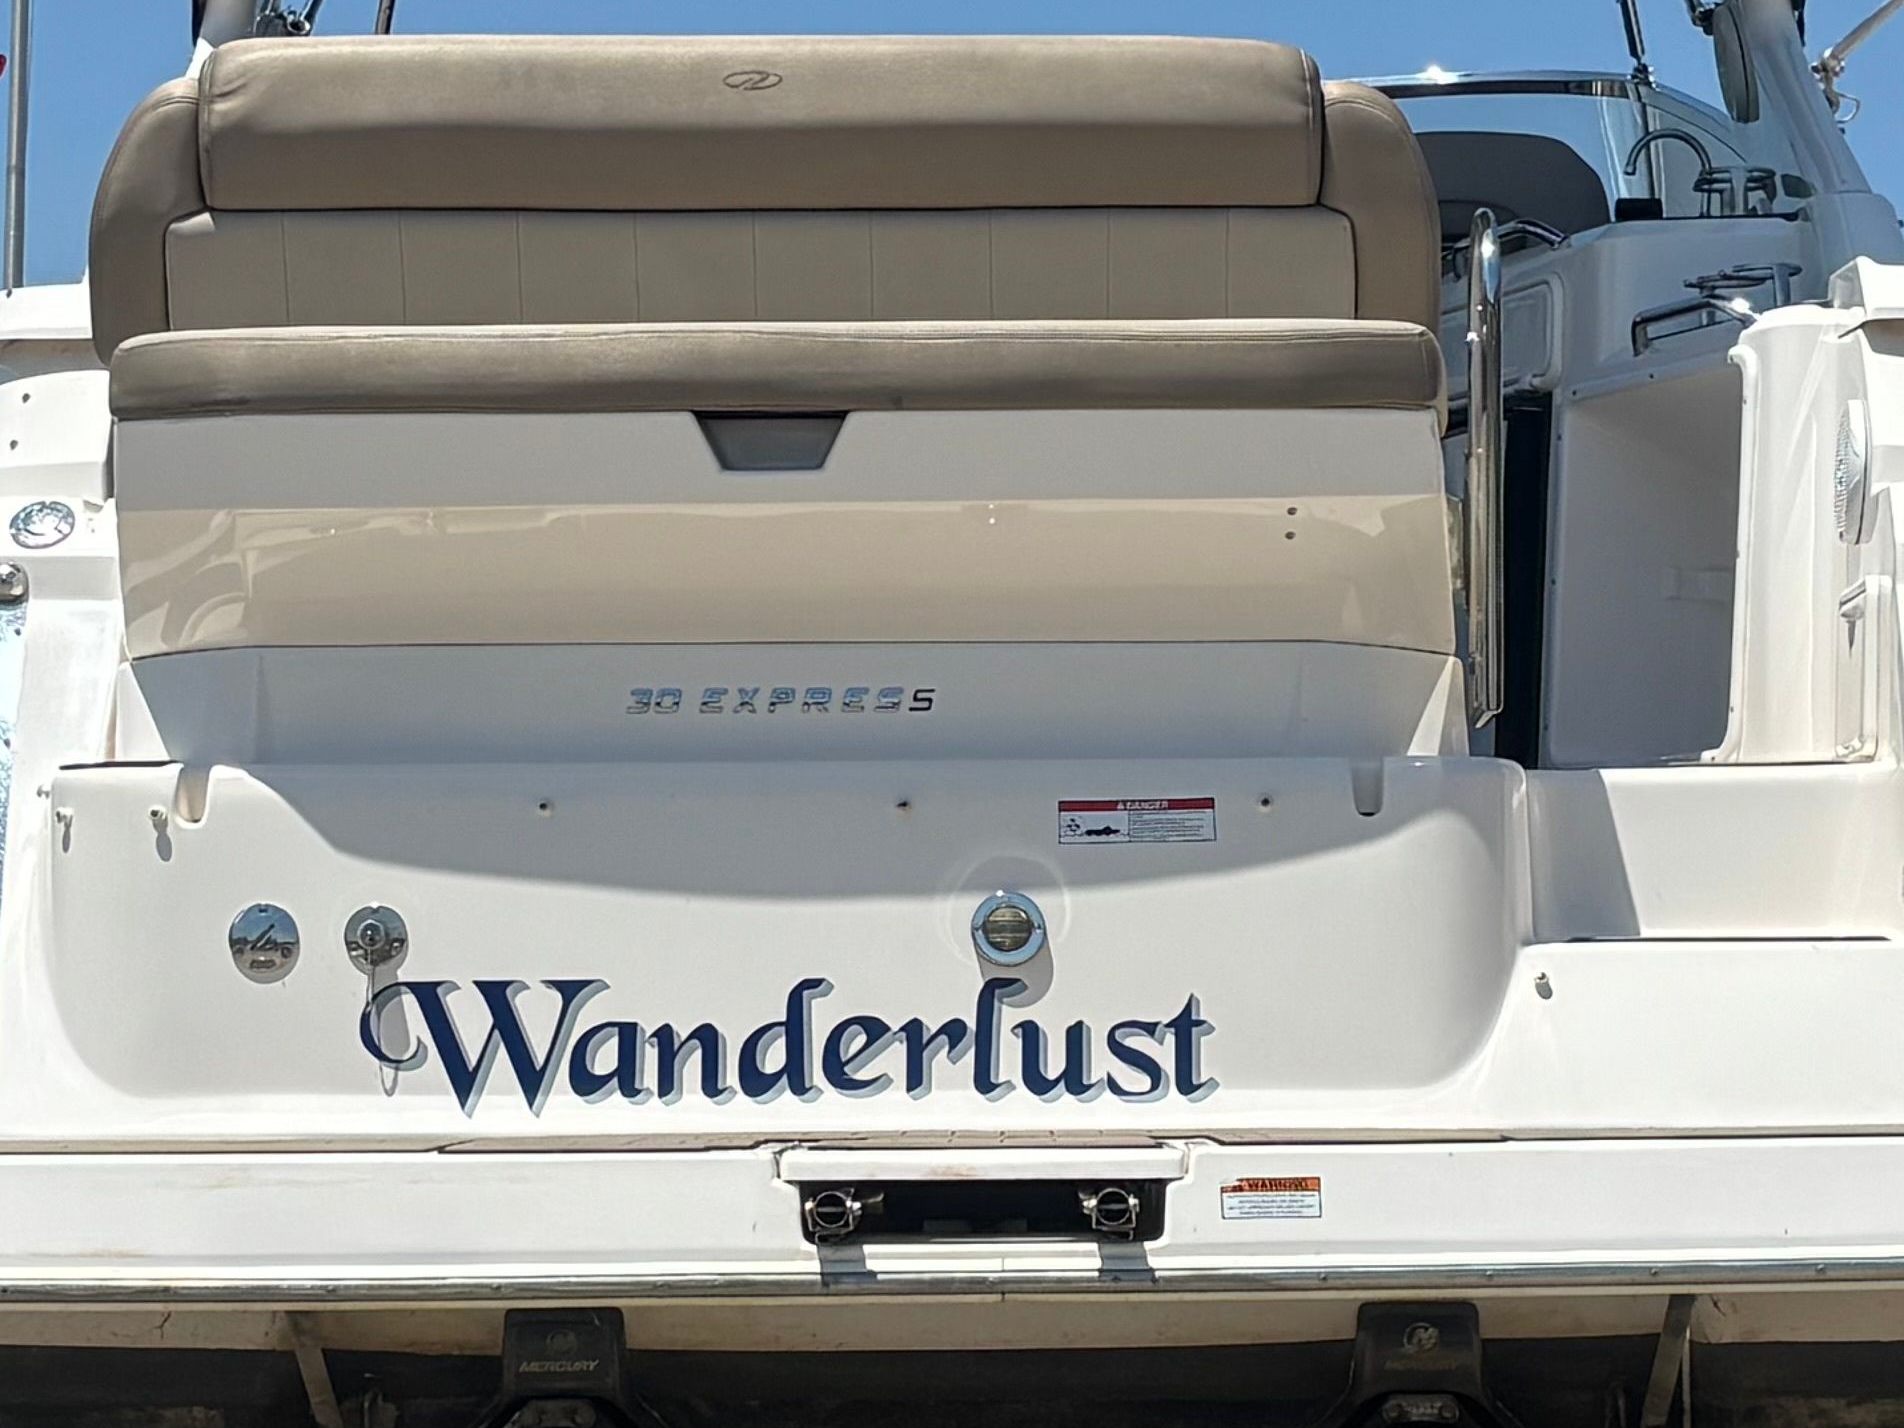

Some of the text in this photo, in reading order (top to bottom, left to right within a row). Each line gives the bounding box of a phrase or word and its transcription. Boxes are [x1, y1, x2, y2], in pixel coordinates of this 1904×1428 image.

[626, 685, 937, 715] 30 EXPRESS
[359, 975, 1220, 1120] Wanderlust
[518, 1358, 600, 1373] MERCURY
